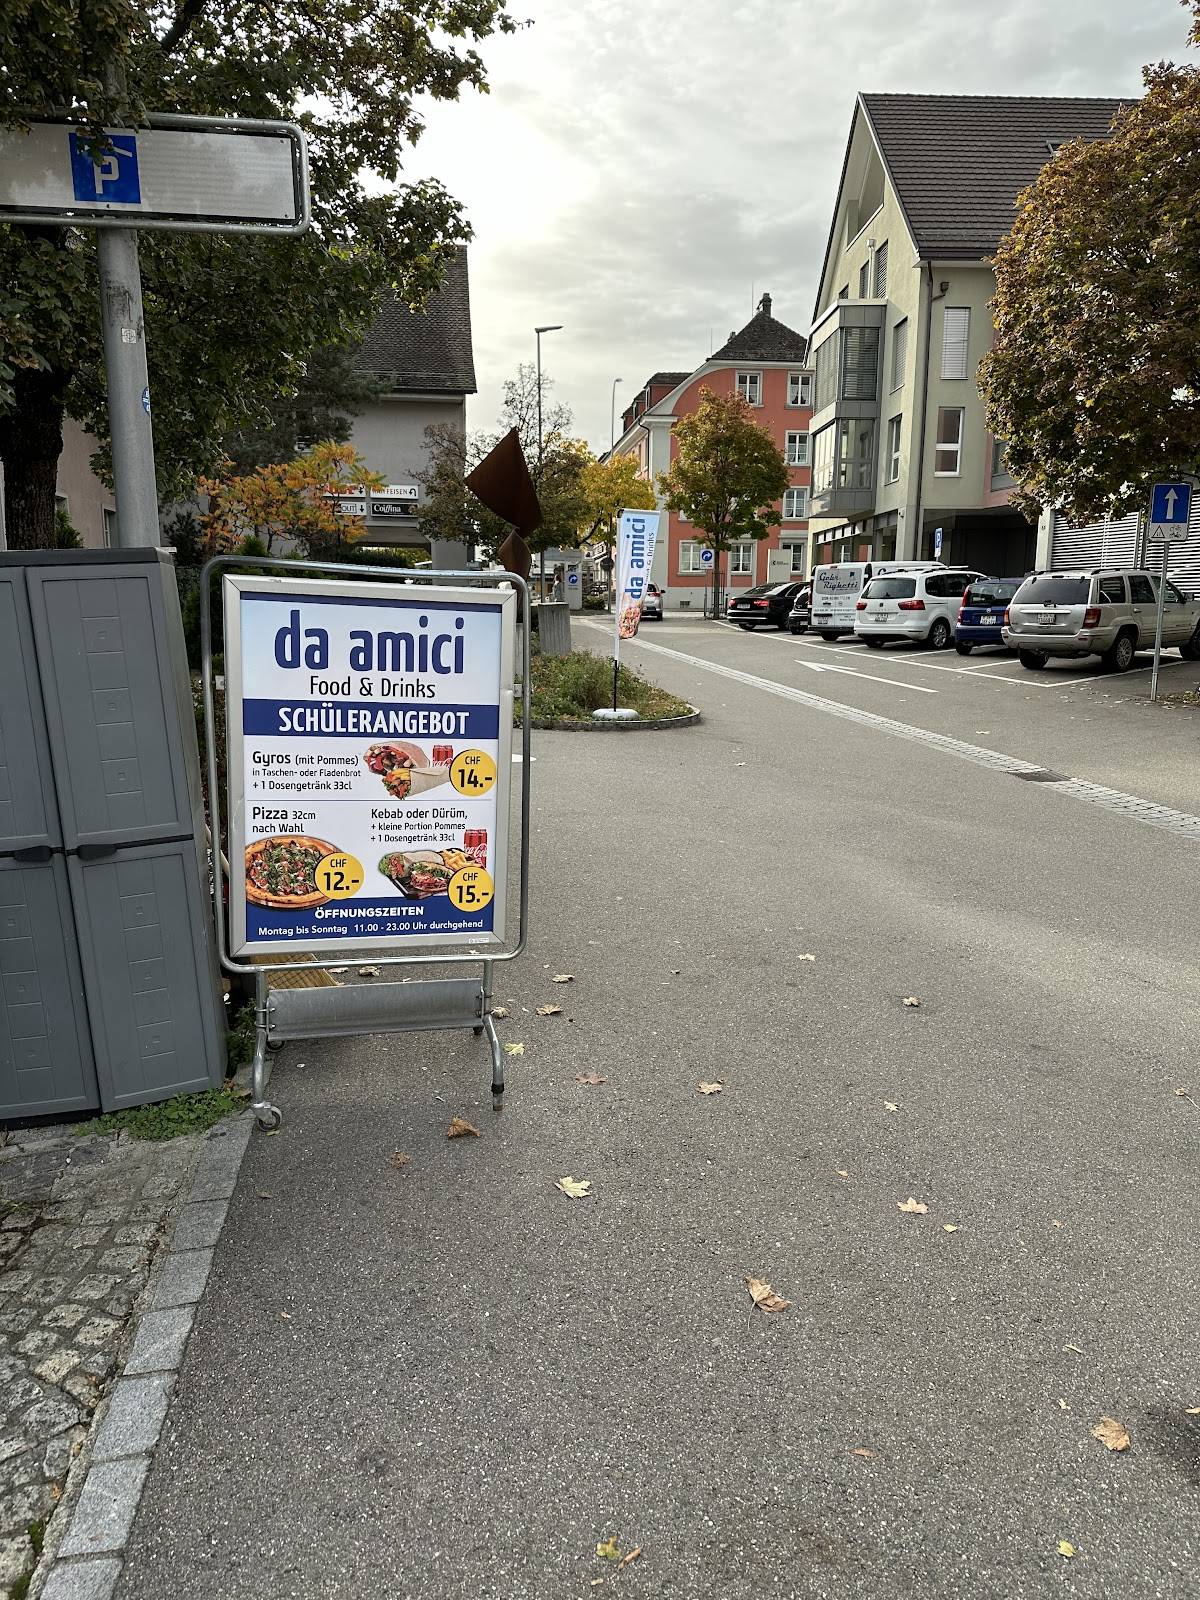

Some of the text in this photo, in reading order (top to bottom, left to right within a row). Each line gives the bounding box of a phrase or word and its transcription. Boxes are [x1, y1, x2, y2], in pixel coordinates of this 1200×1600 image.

[625, 518, 646, 599] da amici
[274, 609, 465, 675] da amici
[310, 675, 436, 699] Food & Drinks
[278, 702, 469, 735] SCHÜLERANGEBOT
[252, 750, 359, 768] Gyros (mit Pommes)
[464, 755, 481, 765] CHF
[252, 768, 361, 778] in Taschen- oder Fladenbrot
[457, 769, 493, 788] 14.-
[261, 781, 265, 790] 1
[268, 780, 331, 792] Dosengetränk
[333, 780, 353, 790] 33cl
[252, 806, 316, 821] Pizza 32cm
[371, 807, 468, 820] Kebab oder Dürüm,
[252, 823, 305, 834] nach Wahl
[378, 822, 402, 831] kleine
[404, 822, 433, 831] Portion
[434, 822, 466, 831] Pommes
[378, 834, 382, 842] 1
[384, 833, 438, 844] Dosengetränk
[439, 833, 455, 842] 33cl
[330, 858, 347, 868] CHF
[323, 872, 360, 892] 12.-
[462, 872, 479, 882] CHF
[456, 885, 490, 904] 15.-
[314, 905, 424, 919] ÖFFNUNGSZEITEN
[258, 926, 294, 938] Montag
[296, 925, 310, 935] bis
[311, 924, 348, 937] Sonntag
[354, 922, 379, 932] 11.00
[386, 921, 411, 931] 23.00
[412, 921, 428, 930] Uhr
[429, 919, 483, 933] durchgehend
